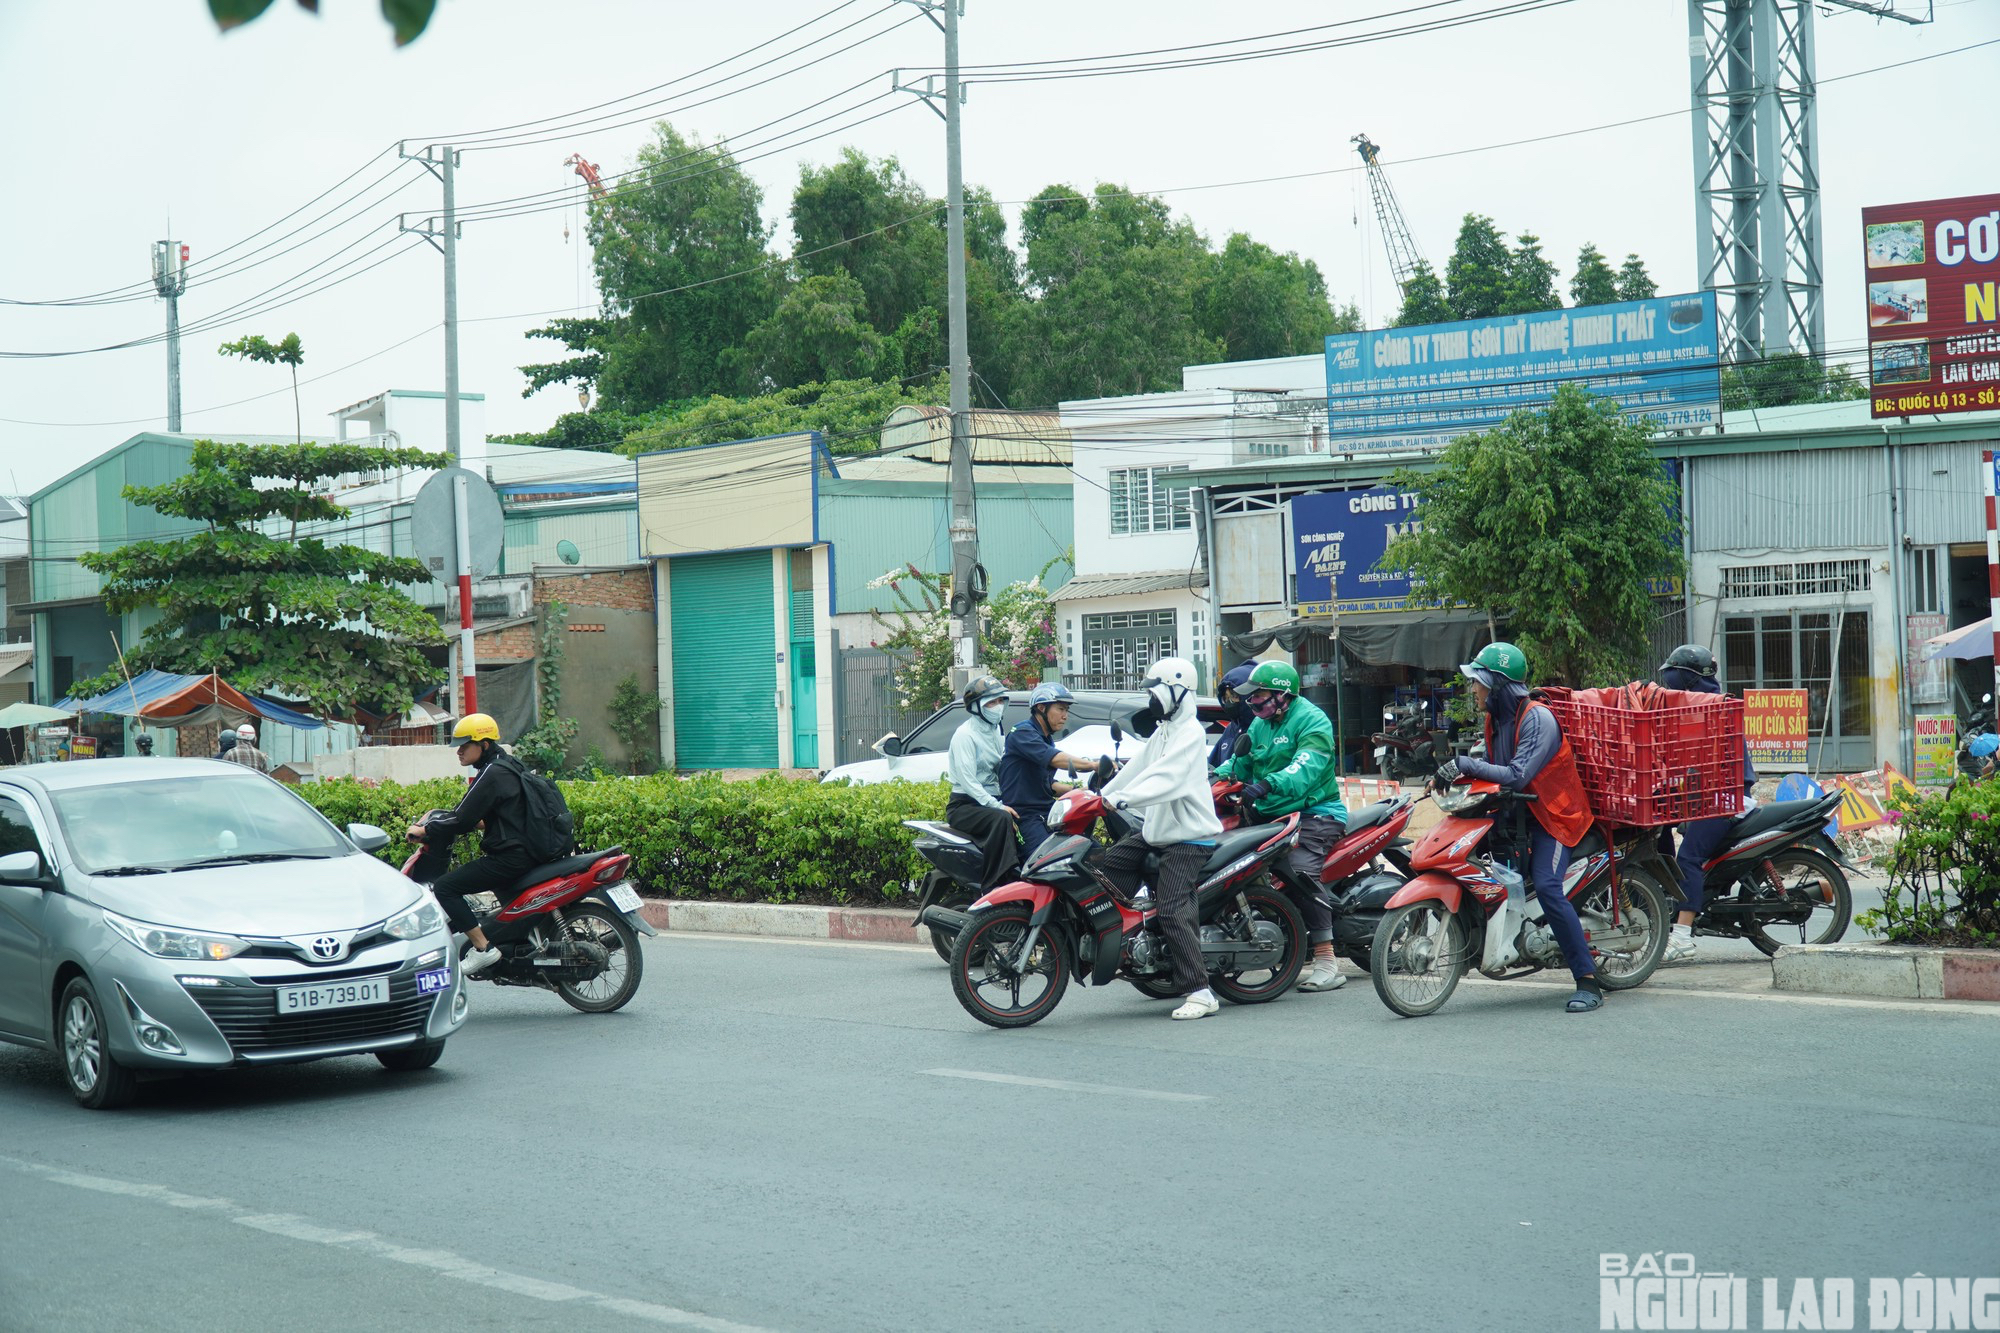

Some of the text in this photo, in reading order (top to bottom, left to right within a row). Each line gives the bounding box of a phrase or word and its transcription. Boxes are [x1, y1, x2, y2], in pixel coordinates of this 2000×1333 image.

[1935, 211, 2000, 265] CƠ
[1374, 304, 1656, 369] CÔNG TY TNHH SƠN MỸ NGHỆ MINH PHÁT
[1942, 363, 1968, 384] LAN
[1875, 398, 1896, 412] ĐC:
[1898, 392, 1931, 411] QUỐC
[1933, 391, 1948, 410] LỘ
[1951, 393, 1966, 406] 13
[1978, 386, 1994, 404] SỐ
[1349, 492, 1421, 514] CÔNG TY
[1312, 532, 1326, 542] CÔNG
[1314, 561, 1346, 573] PAINT
[1272, 677, 1291, 687] Grab
[1771, 690, 1803, 708] TUYỂN
[1744, 708, 1808, 739] THỢ CỬA SẮT
[1917, 717, 1955, 735] NƯỚC MÍA
[1756, 740, 1784, 750] LƯỢNG:
[1792, 740, 1807, 750] THỢ
[1088, 901, 1113, 916] YAMAHA
[420, 974, 437, 992] TẬP
[288, 983, 379, 1009] 51B-739.01
